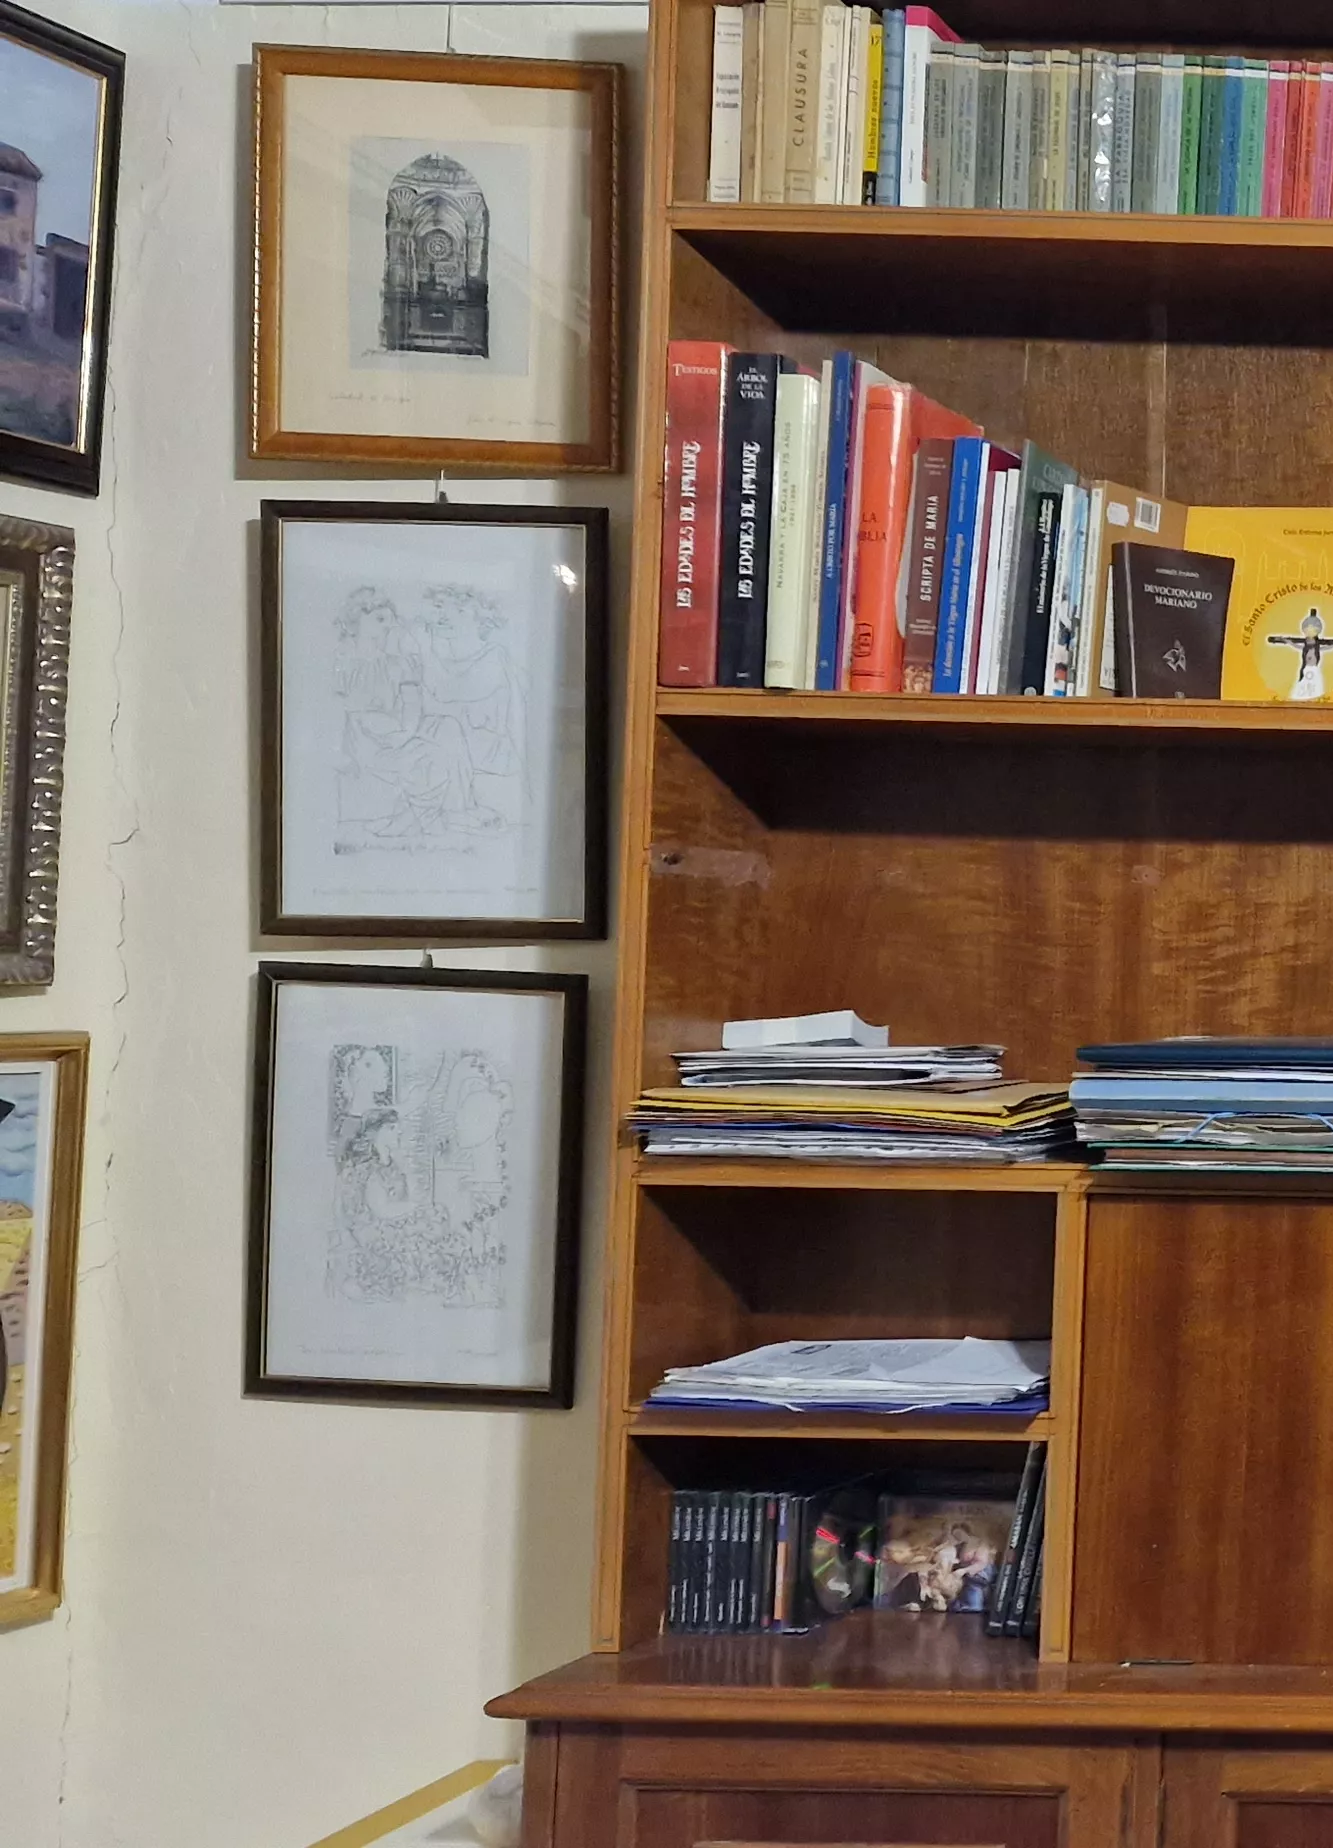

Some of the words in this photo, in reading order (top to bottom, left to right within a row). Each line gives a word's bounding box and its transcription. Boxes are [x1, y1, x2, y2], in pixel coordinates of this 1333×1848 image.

[792, 48, 808, 147] CLAUSURA
[739, 390, 766, 400] VIDA
[680, 440, 702, 497] HOMBRE
[739, 440, 761, 495] HOMBRE
[925, 494, 940, 531] MARIA
[677, 525, 694, 583] EDADES
[738, 520, 755, 575] EDADES
[924, 536, 937, 550] DE
[919, 555, 935, 602] SCRIPTA
[1144, 583, 1213, 602] DEVOCIONARIO
[1155, 595, 1198, 609] MARIANO
